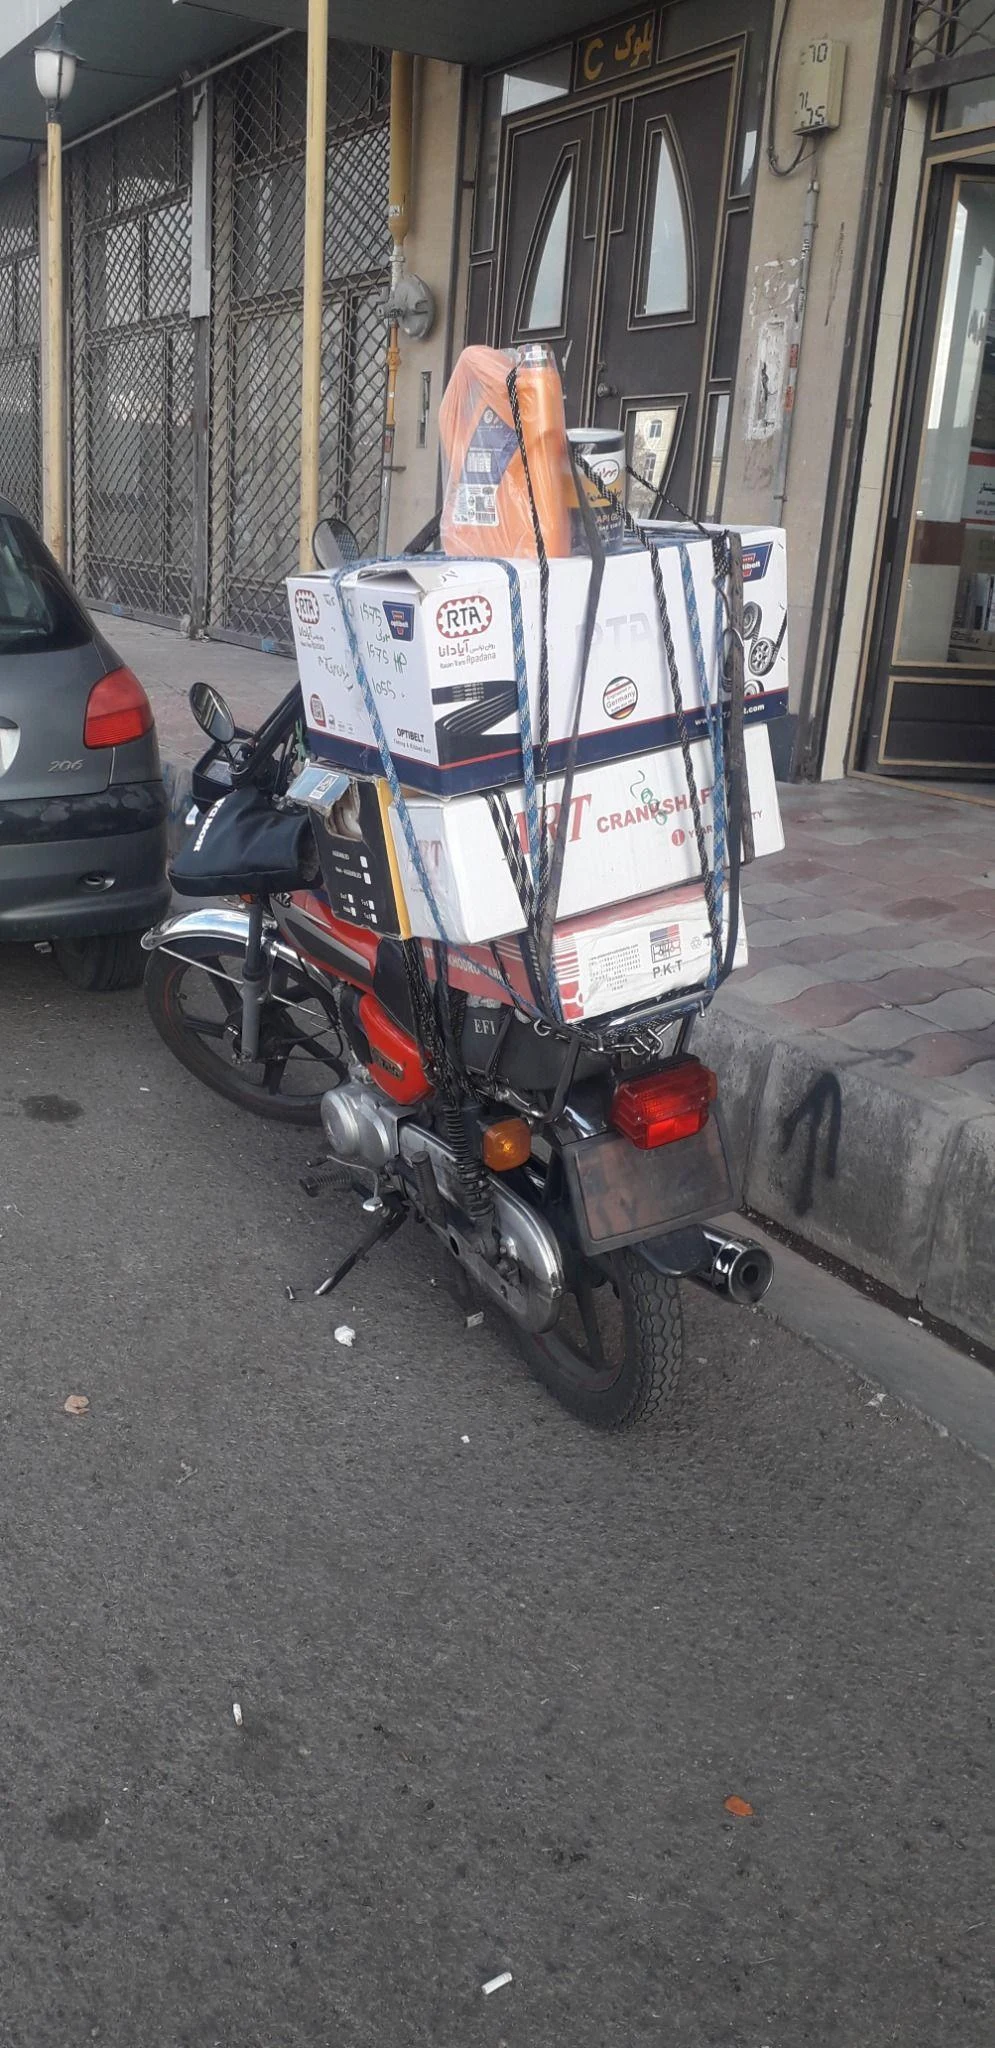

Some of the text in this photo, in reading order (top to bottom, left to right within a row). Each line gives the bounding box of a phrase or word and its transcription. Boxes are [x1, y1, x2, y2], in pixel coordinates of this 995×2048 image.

[584, 38, 604, 80] C
[299, 598, 316, 616] RTA
[446, 605, 482, 629] RTA
[606, 690, 636, 709] Germany
[396, 727, 425, 743] OPTIBELT
[48, 759, 83, 772] 206
[597, 787, 714, 833] CRANKSHF
[688, 825, 713, 839] YAR
[653, 960, 683, 979] P.K.T
[474, 1018, 496, 1035] EFI
